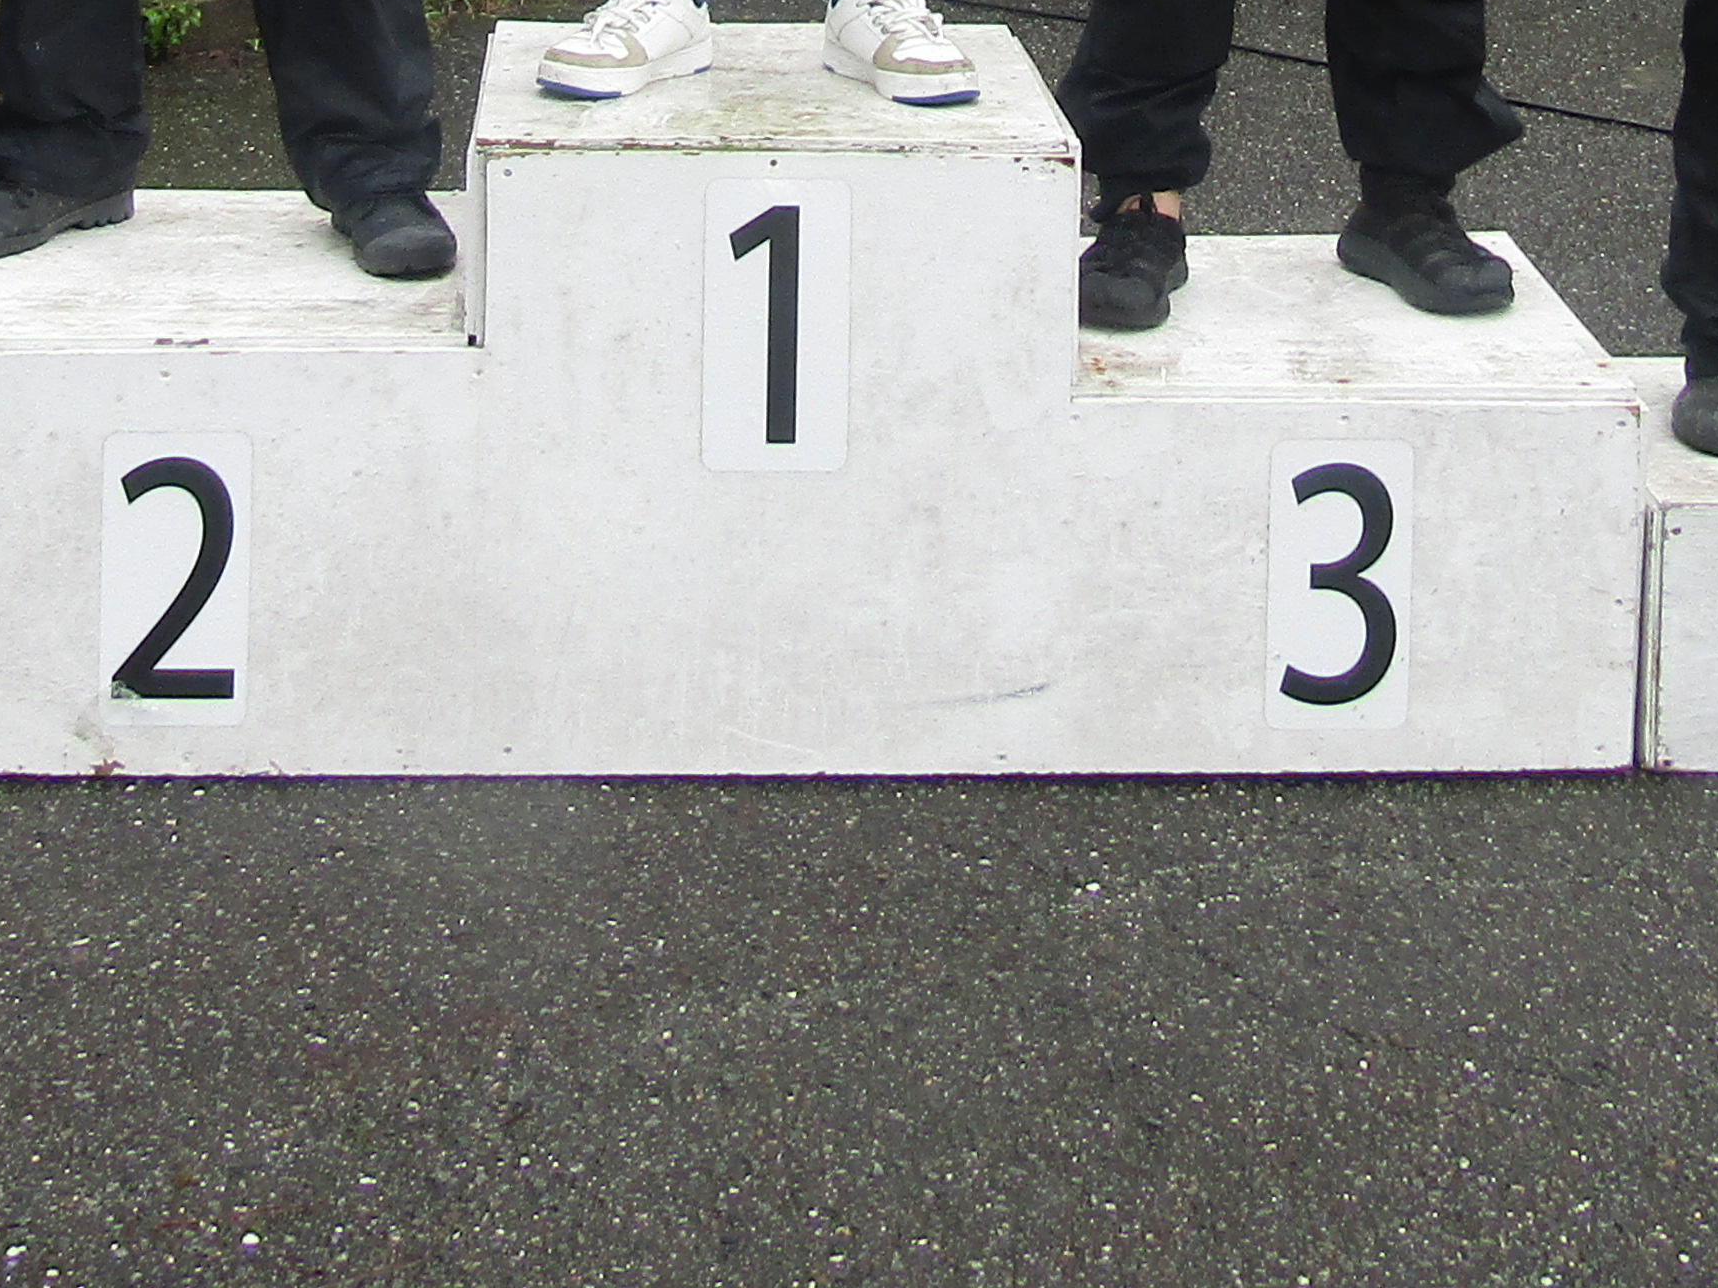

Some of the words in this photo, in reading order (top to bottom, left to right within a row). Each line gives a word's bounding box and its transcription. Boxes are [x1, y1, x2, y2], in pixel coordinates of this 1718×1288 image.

[730, 207, 799, 443] 1
[112, 458, 234, 699] 2
[1280, 464, 1396, 705] 3
